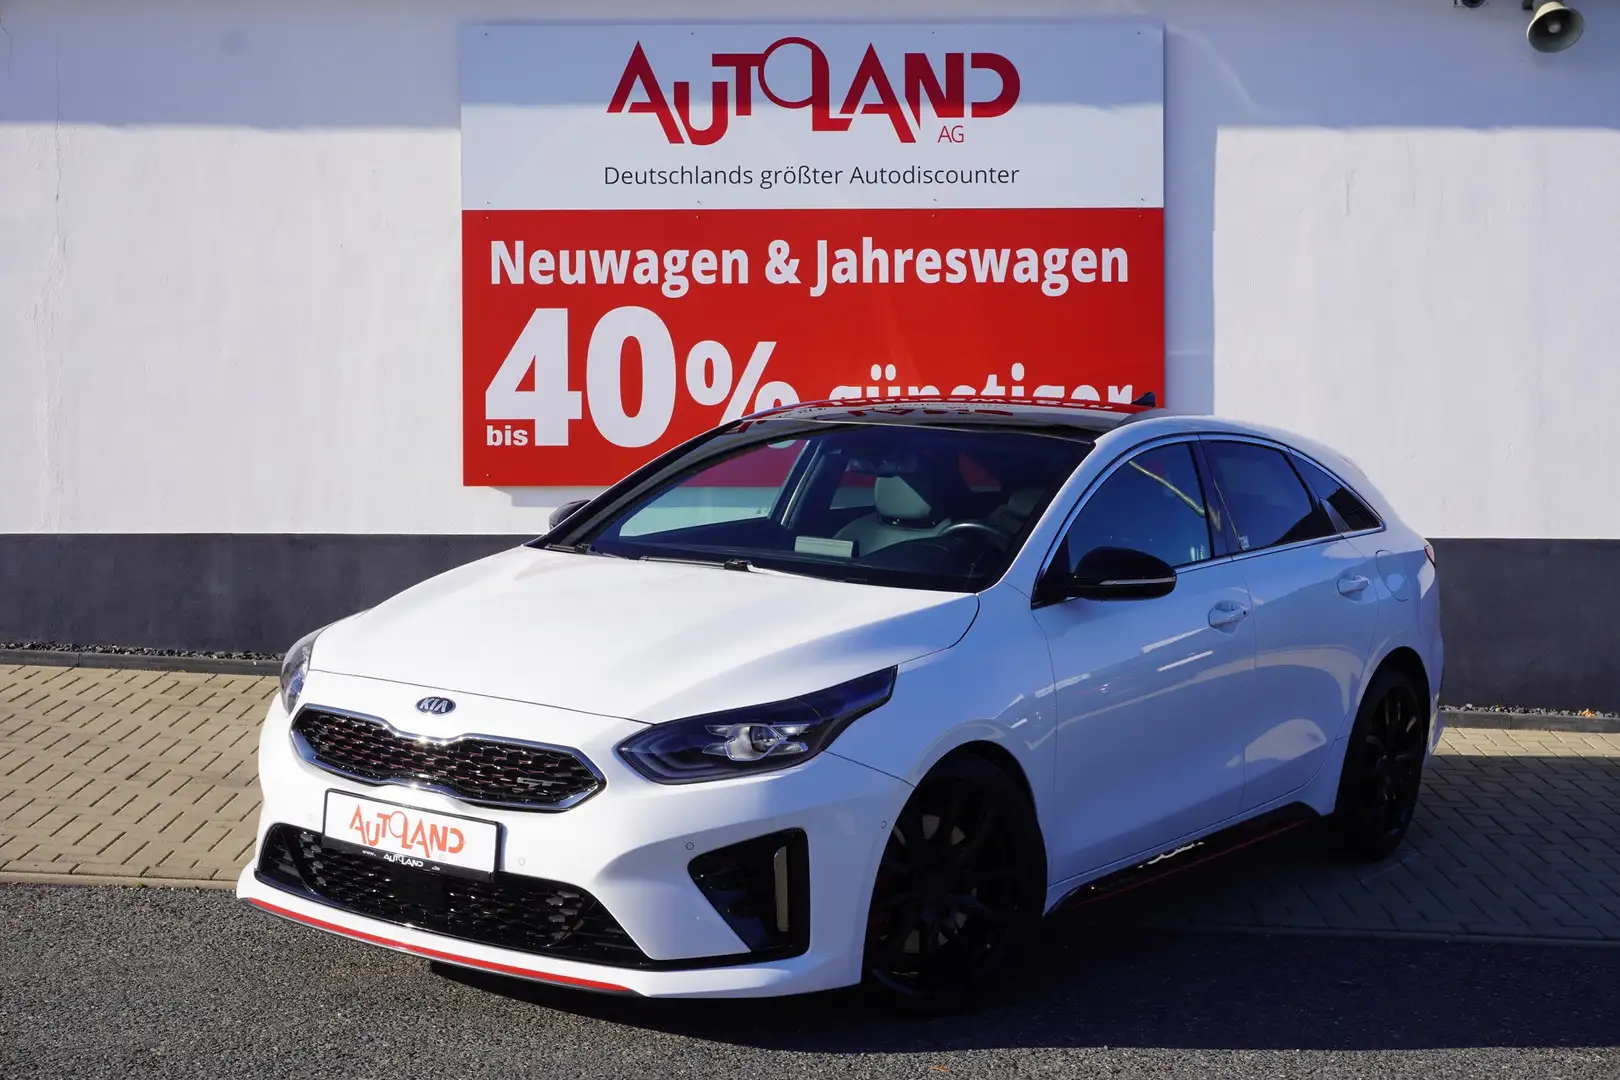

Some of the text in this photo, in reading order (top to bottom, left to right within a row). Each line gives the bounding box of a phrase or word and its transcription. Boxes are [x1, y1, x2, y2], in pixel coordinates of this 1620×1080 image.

[606, 37, 1021, 146] AUTOLAND
[938, 125, 965, 143] AG
[604, 165, 1020, 190] Deutschlands größter Autodiscounter
[491, 237, 1128, 298] Neuwagen & Jahreswagen
[486, 425, 529, 447] bis
[419, 698, 449, 713] KIA
[349, 804, 465, 858] AUTOLAND
